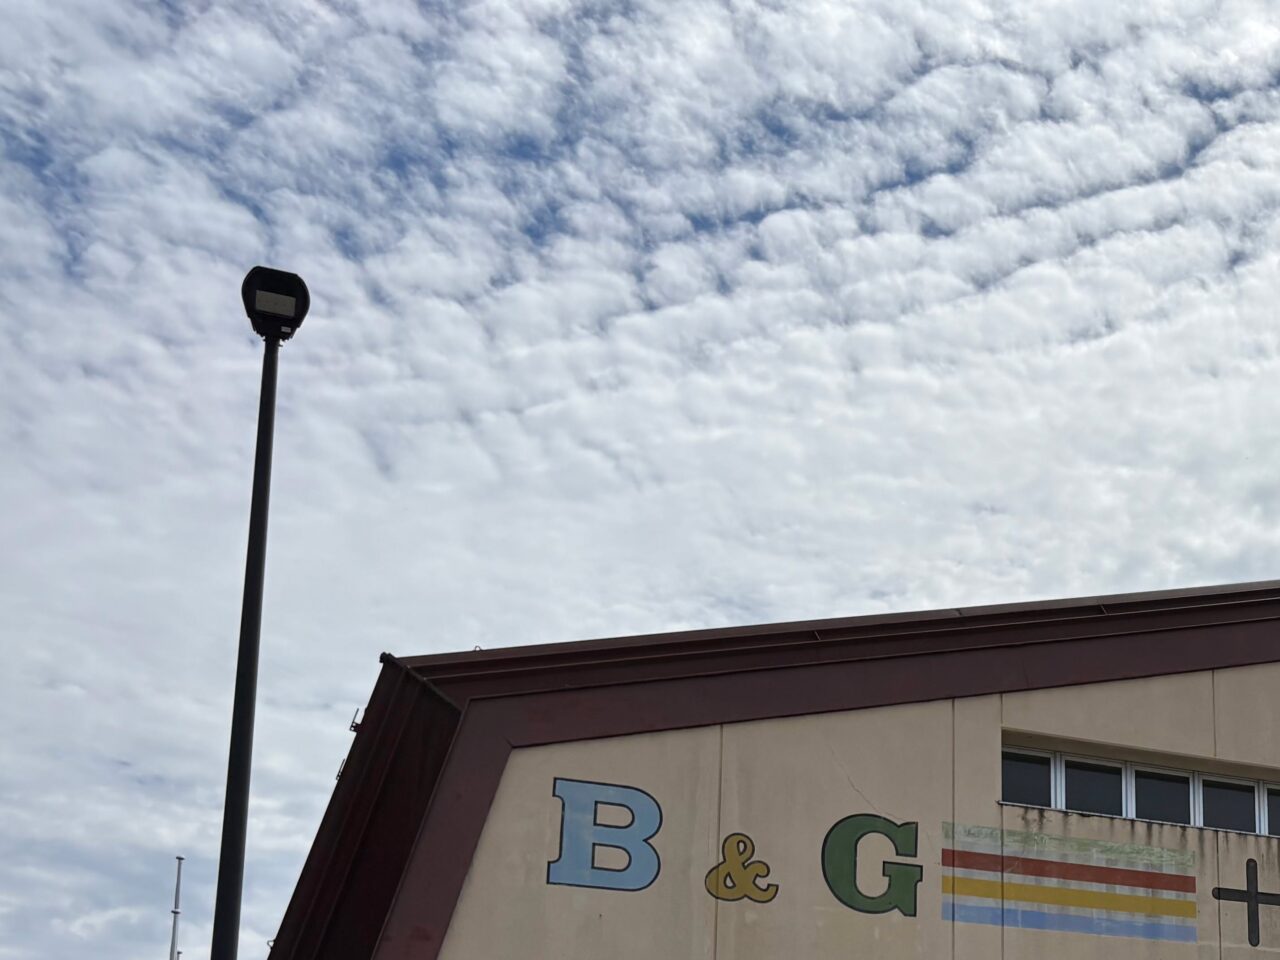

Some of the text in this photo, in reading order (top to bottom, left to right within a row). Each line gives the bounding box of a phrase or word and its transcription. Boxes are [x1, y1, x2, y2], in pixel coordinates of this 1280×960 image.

[547, 777, 662, 892] B
[705, 832, 779, 904] &
[821, 813, 924, 918] G
